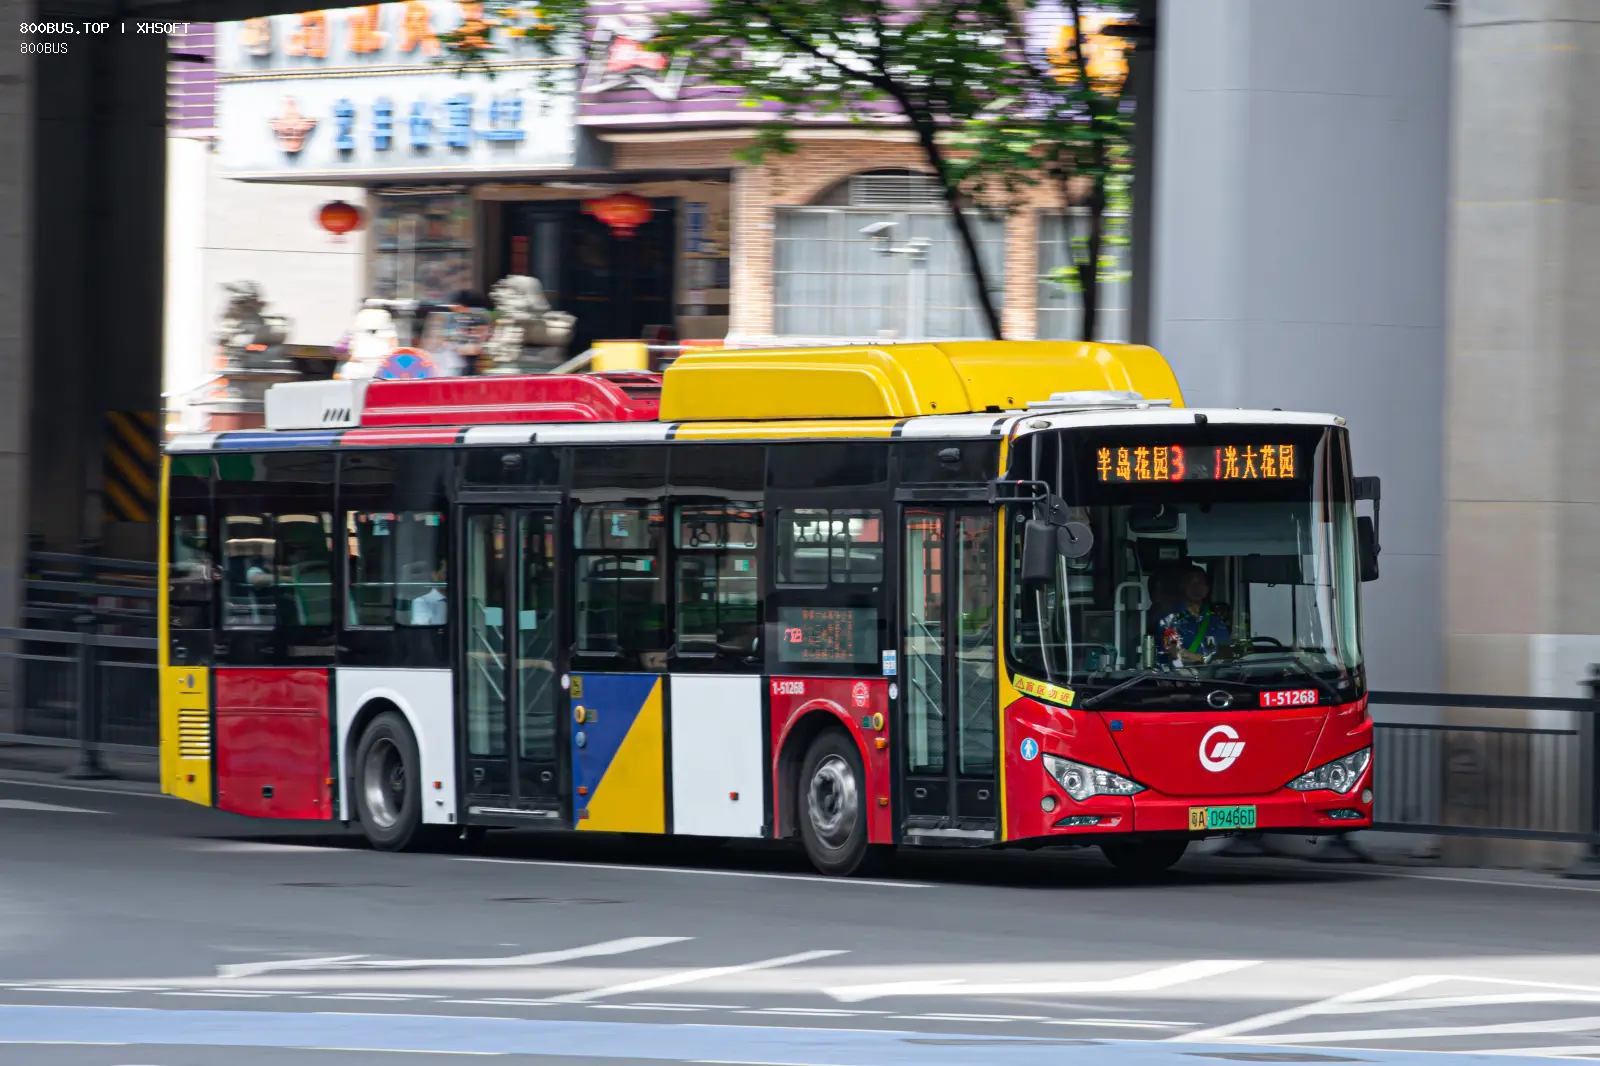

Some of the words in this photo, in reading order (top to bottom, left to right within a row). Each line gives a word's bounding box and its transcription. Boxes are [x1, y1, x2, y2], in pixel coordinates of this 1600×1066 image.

[1097, 446, 1169, 480] 半岛花园
[1223, 444, 1294, 479] 光大花园
[773, 681, 805, 695] 1-51268
[1026, 681, 1070, 703] 盲区勿近
[1263, 690, 1315, 706] 1-51268
